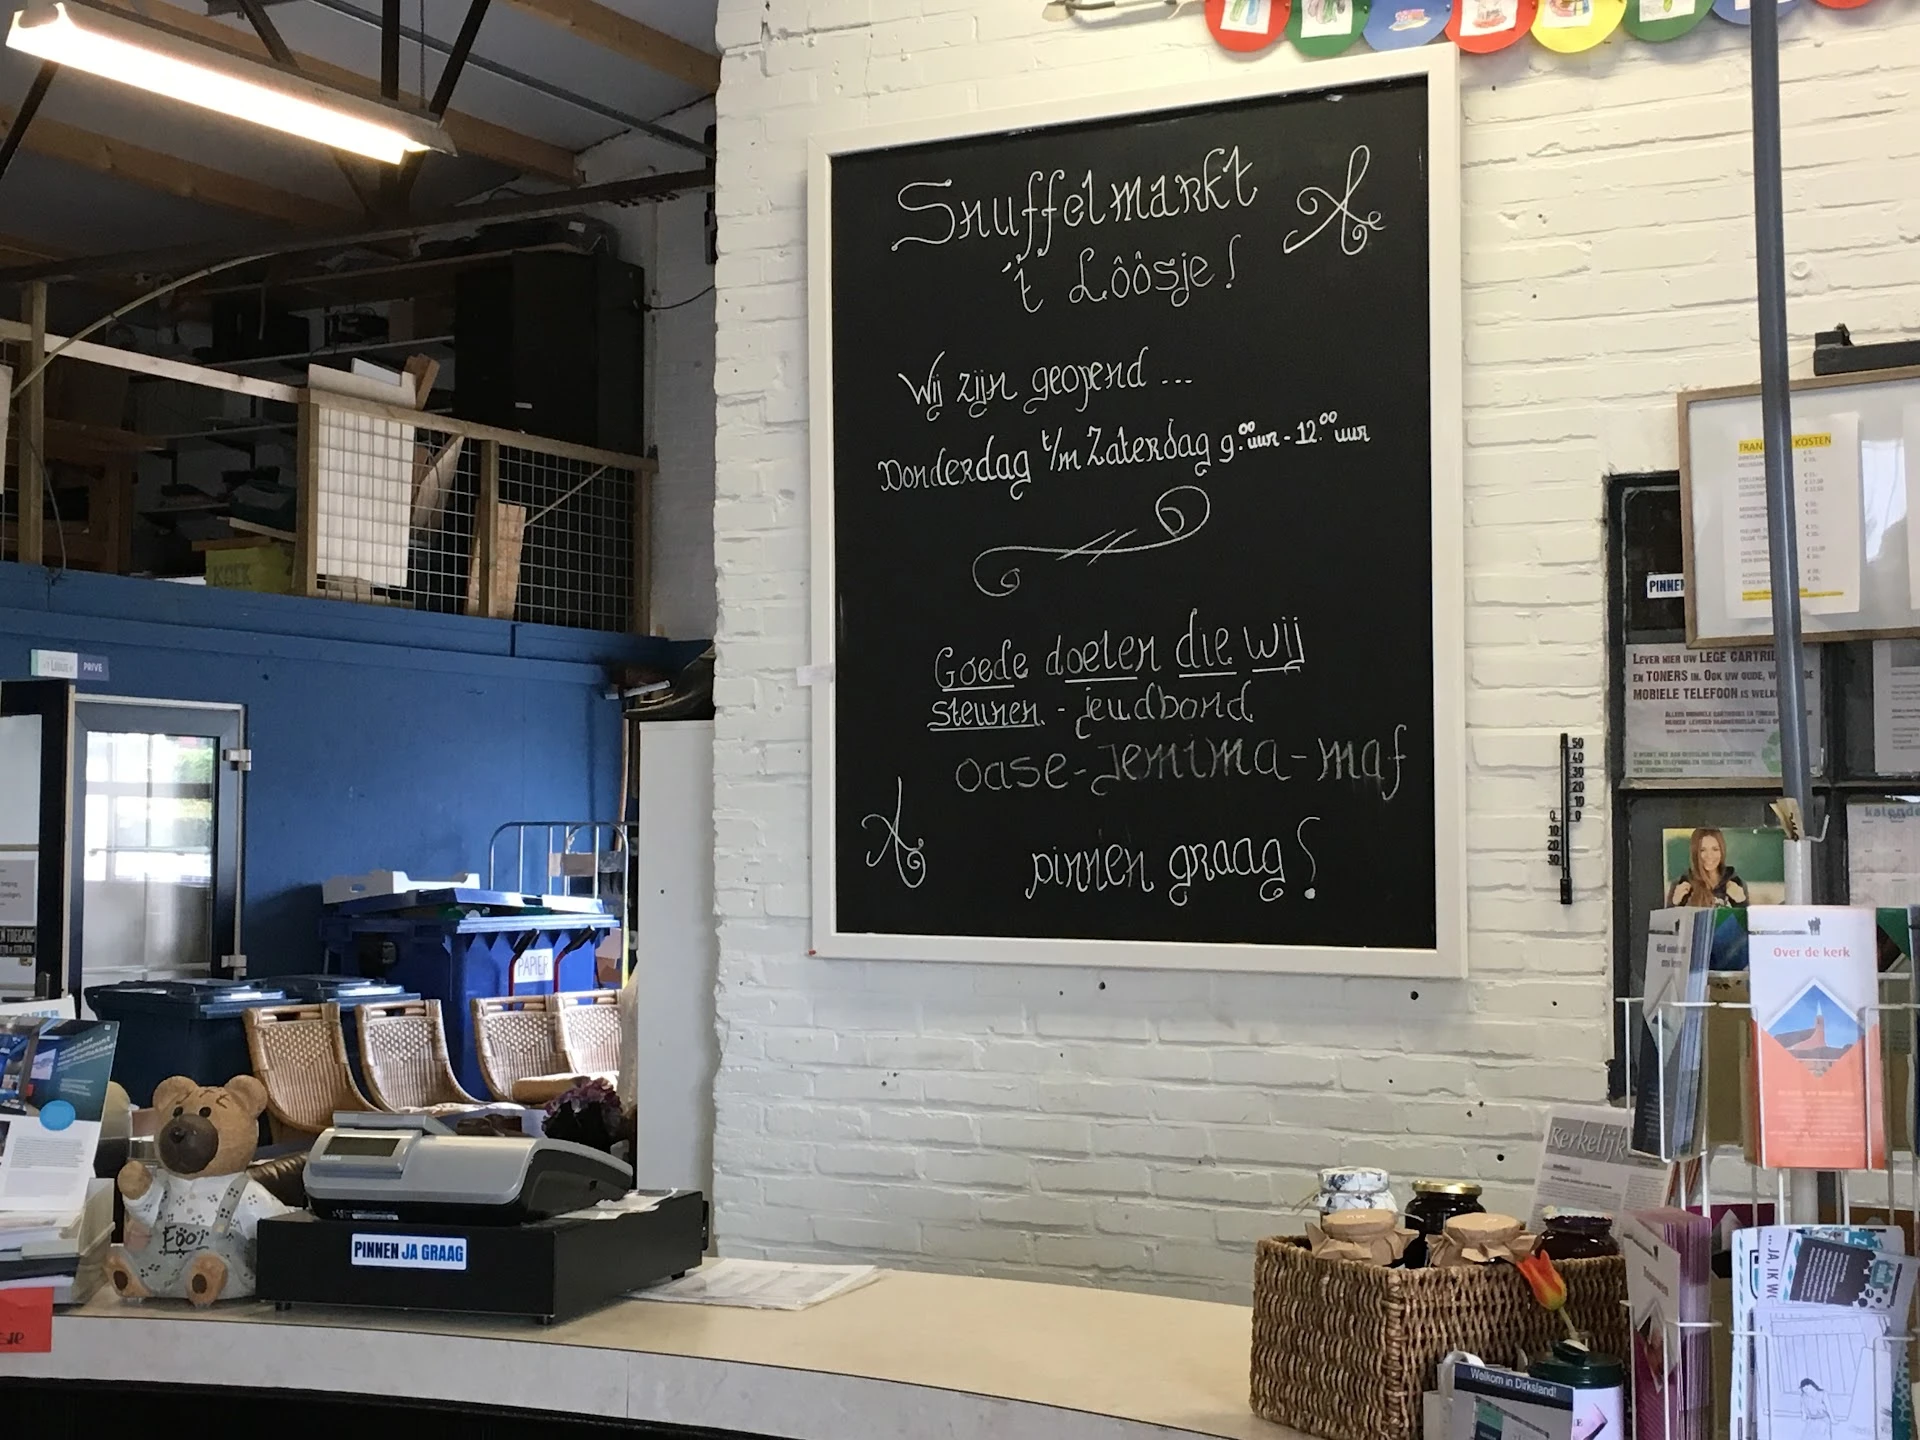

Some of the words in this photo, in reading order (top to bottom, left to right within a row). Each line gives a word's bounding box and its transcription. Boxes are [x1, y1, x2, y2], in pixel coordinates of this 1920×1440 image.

[891, 145, 1258, 261] Snuffelmarkt
[956, 369, 1018, 418] zijn
[1023, 346, 1149, 412] geopend
[877, 434, 1032, 500] Donderdag
[1085, 418, 1211, 477] Zaterdag
[935, 639, 1029, 690] Goede
[1175, 608, 1234, 670] die
[1699, 651, 1727, 663] LEGE
[83, 661, 103, 673] PRIVE
[1646, 670, 1688, 682] TONERS
[1633, 688, 1680, 700] MOBIELE
[1683, 687, 1738, 699] TELEFOON
[1026, 844, 1155, 899] pinnen
[1773, 947, 1800, 958] Over
[1804, 946, 1819, 958] de
[1823, 946, 1851, 958] kerk
[517, 956, 549, 976] PAPIER
[1548, 1121, 1628, 1162] Kerkelijk
[354, 1241, 399, 1260] PINNEN
[401, 1243, 418, 1261] JA
[421, 1244, 464, 1262] GRAAG
[1470, 1367, 1504, 1386] Welkom
[1505, 1376, 1513, 1388] in
[1514, 1377, 1557, 1398] Dirksland!
